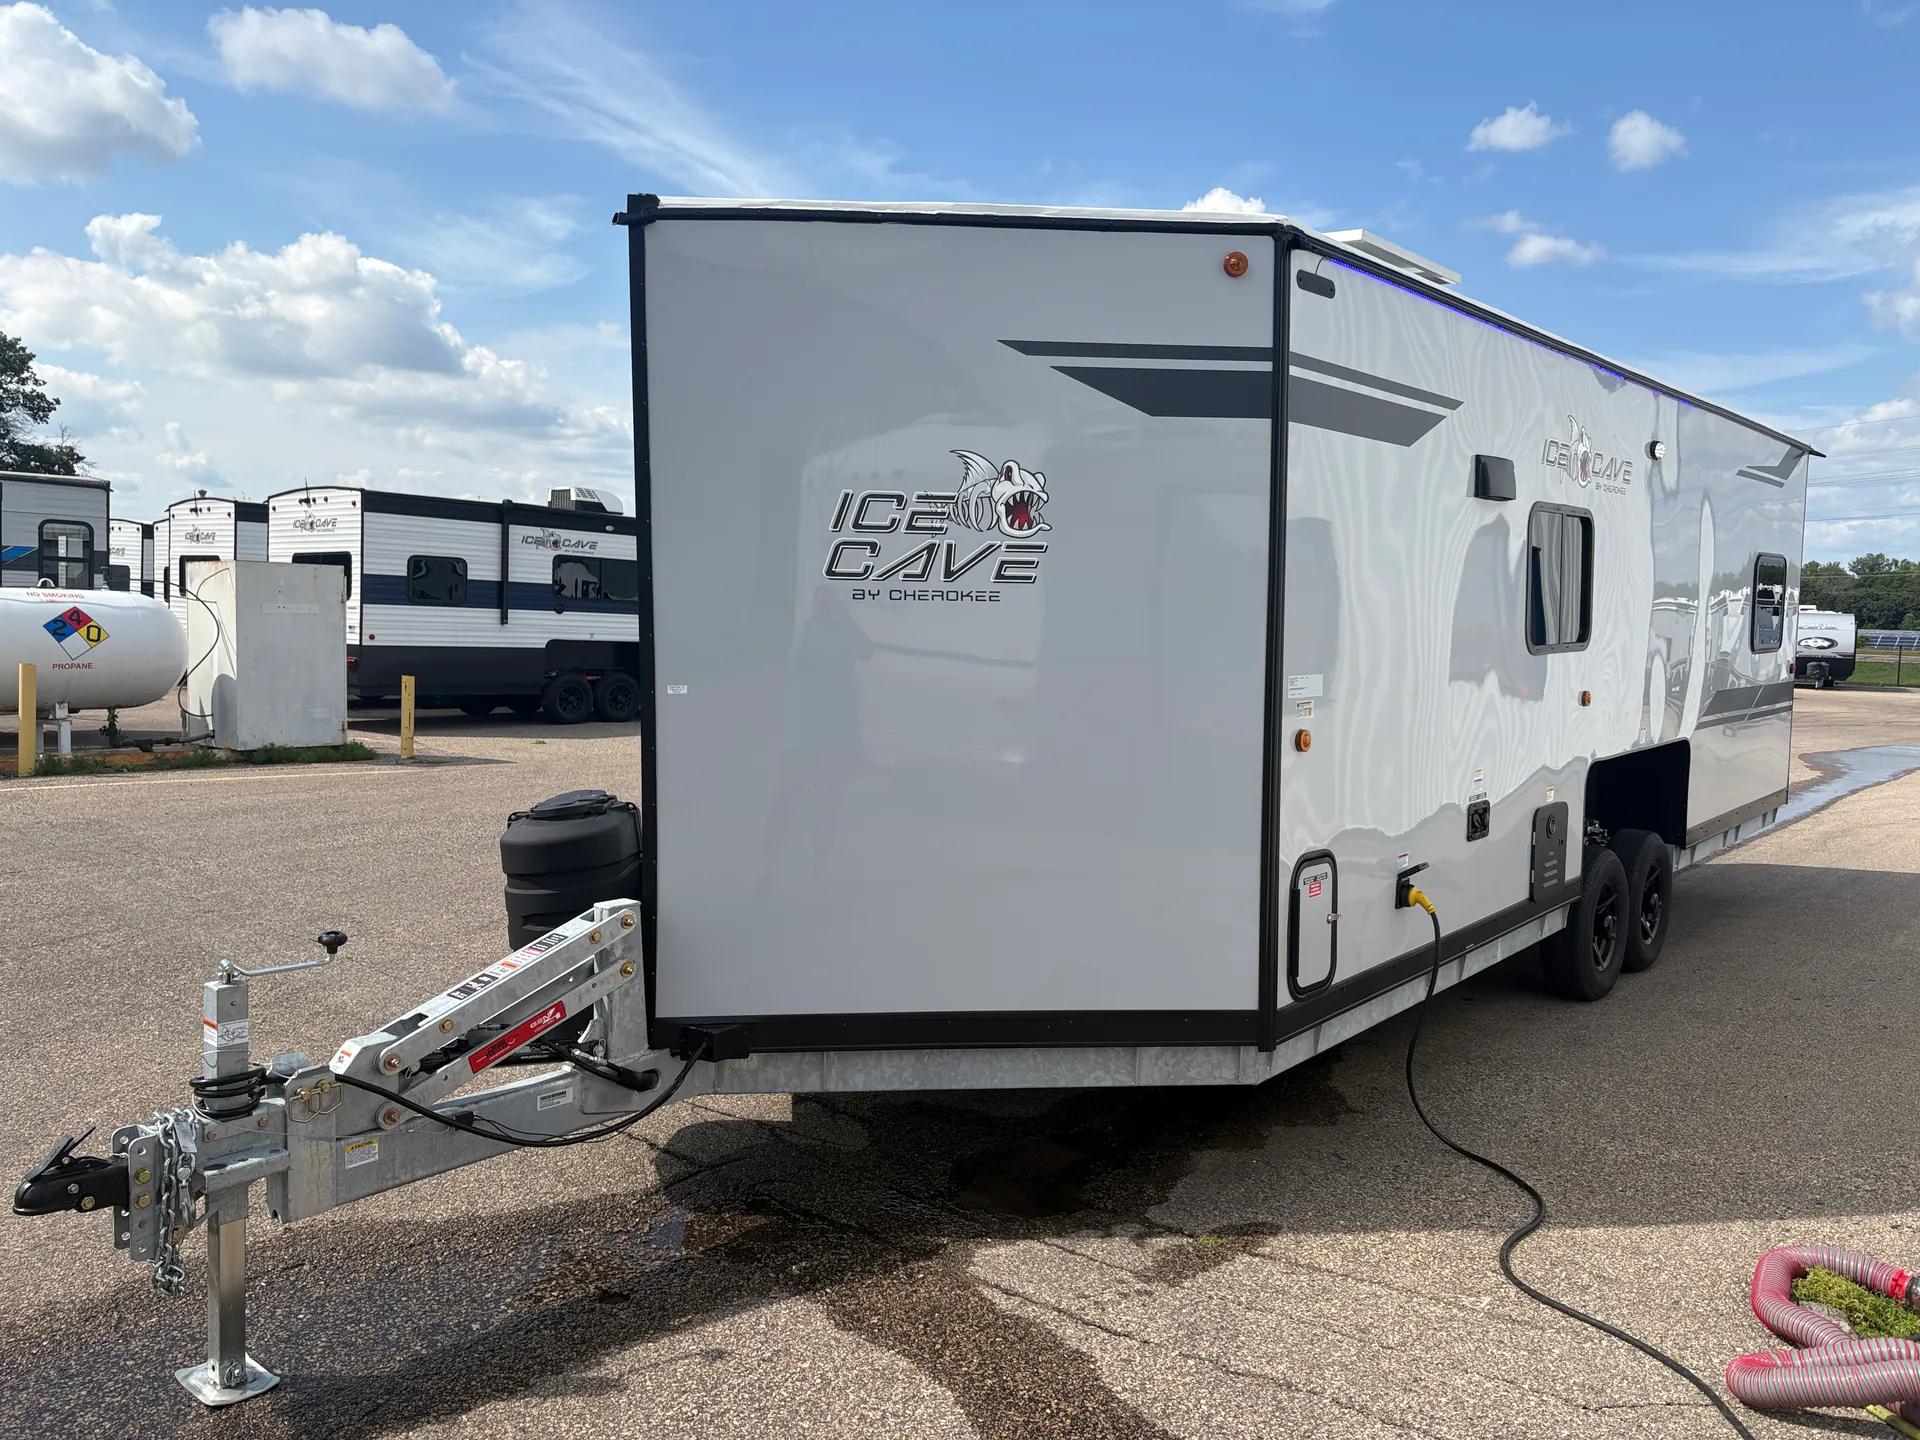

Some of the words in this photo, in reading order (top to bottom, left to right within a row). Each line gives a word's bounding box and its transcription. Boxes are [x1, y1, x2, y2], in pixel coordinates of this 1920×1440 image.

[1541, 437, 1570, 469] ICE
[1592, 452, 1633, 485] CAVE
[829, 489, 959, 535] ICE
[315, 518, 337, 527] CAVE
[521, 535, 543, 546] ICE
[562, 538, 598, 550] CAVE
[822, 537, 1049, 584] CAVE
[852, 589, 880, 600] BY
[889, 589, 1001, 602] CHEROKEE
[68, 609, 83, 626] 4
[52, 619, 68, 638] 2
[86, 624, 101, 643] 0
[52, 662, 94, 670] PROPANE
